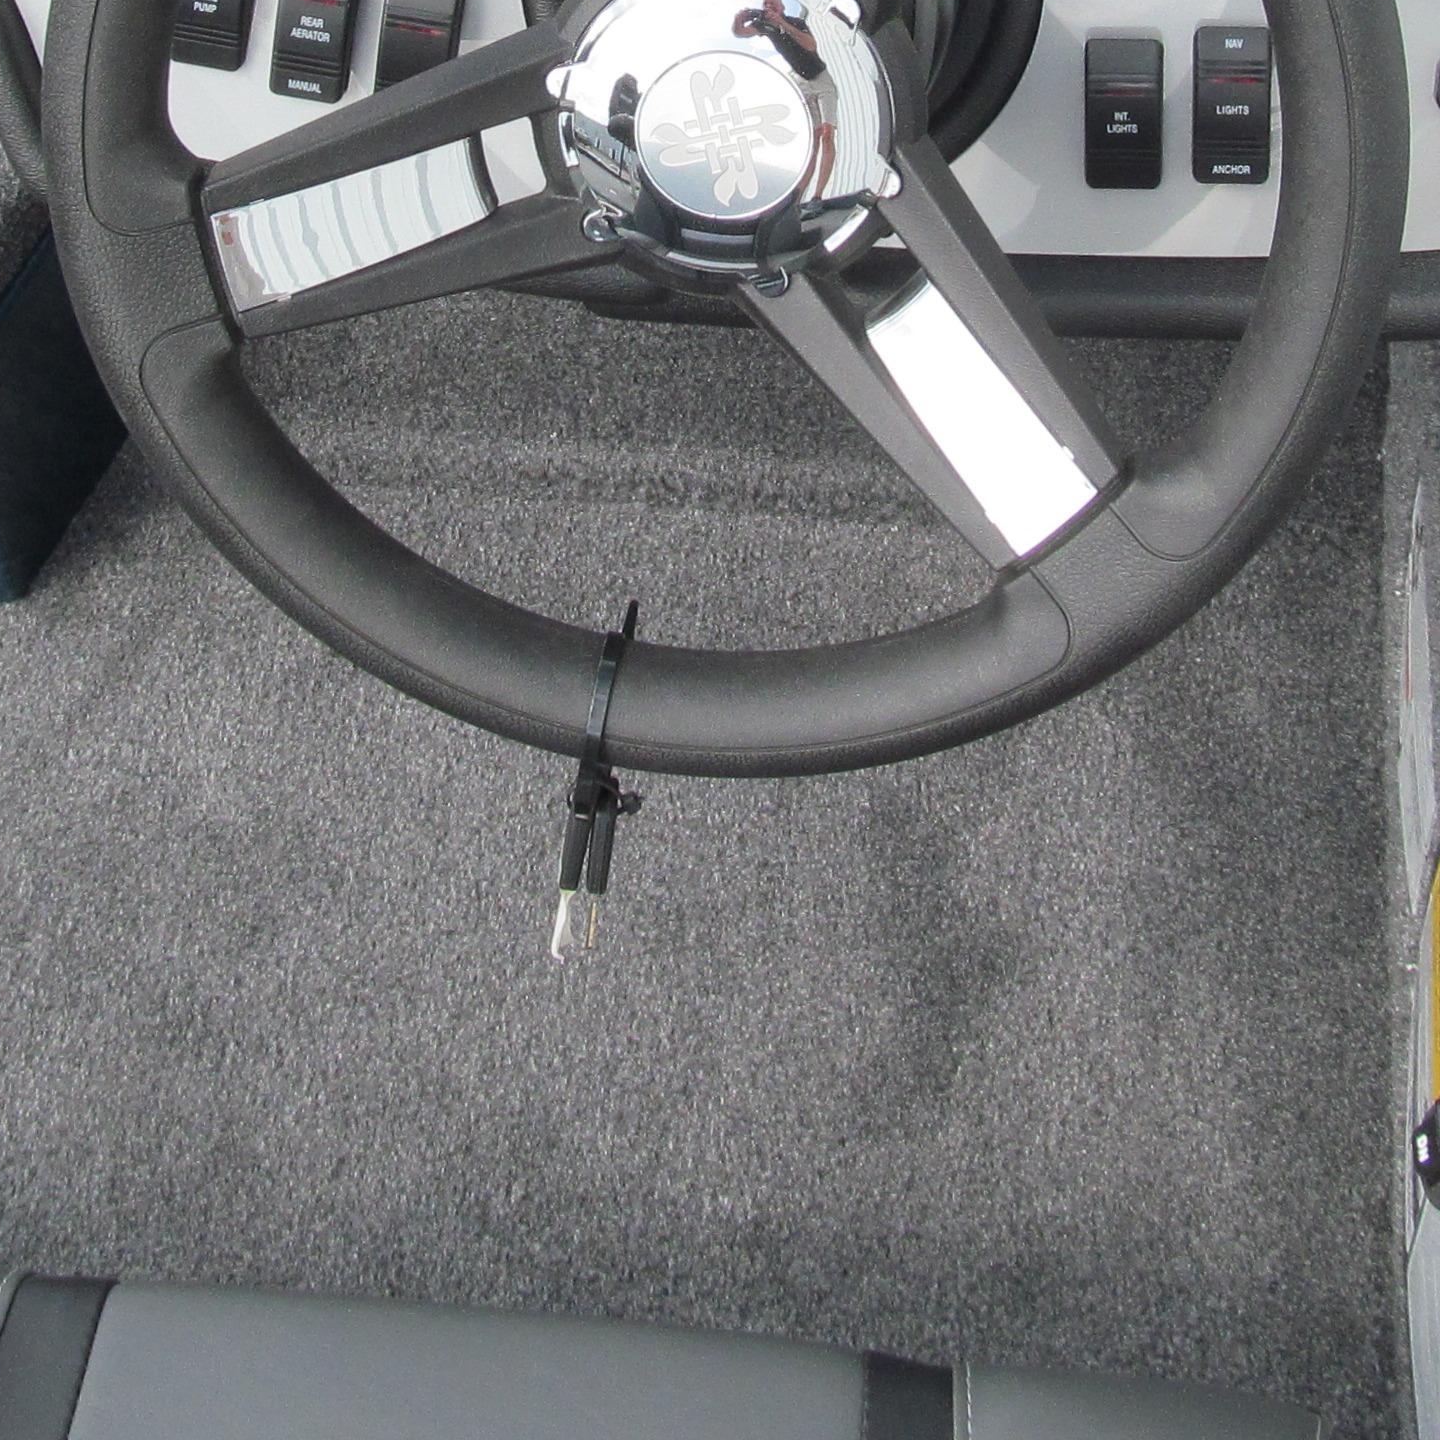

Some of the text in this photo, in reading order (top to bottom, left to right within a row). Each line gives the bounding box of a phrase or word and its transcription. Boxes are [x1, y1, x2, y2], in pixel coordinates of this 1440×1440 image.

[193, 1, 217, 14] PUMP
[299, 15, 324, 29] REAR
[290, 28, 331, 44] AERATOR
[1224, 38, 1244, 50] NAV
[287, 79, 322, 95] MANUAL
[1114, 111, 1131, 122] INT.
[1215, 105, 1250, 116] LIGHTS
[1106, 123, 1138, 134] LIGHTS
[1212, 164, 1251, 175] ANCHOR
